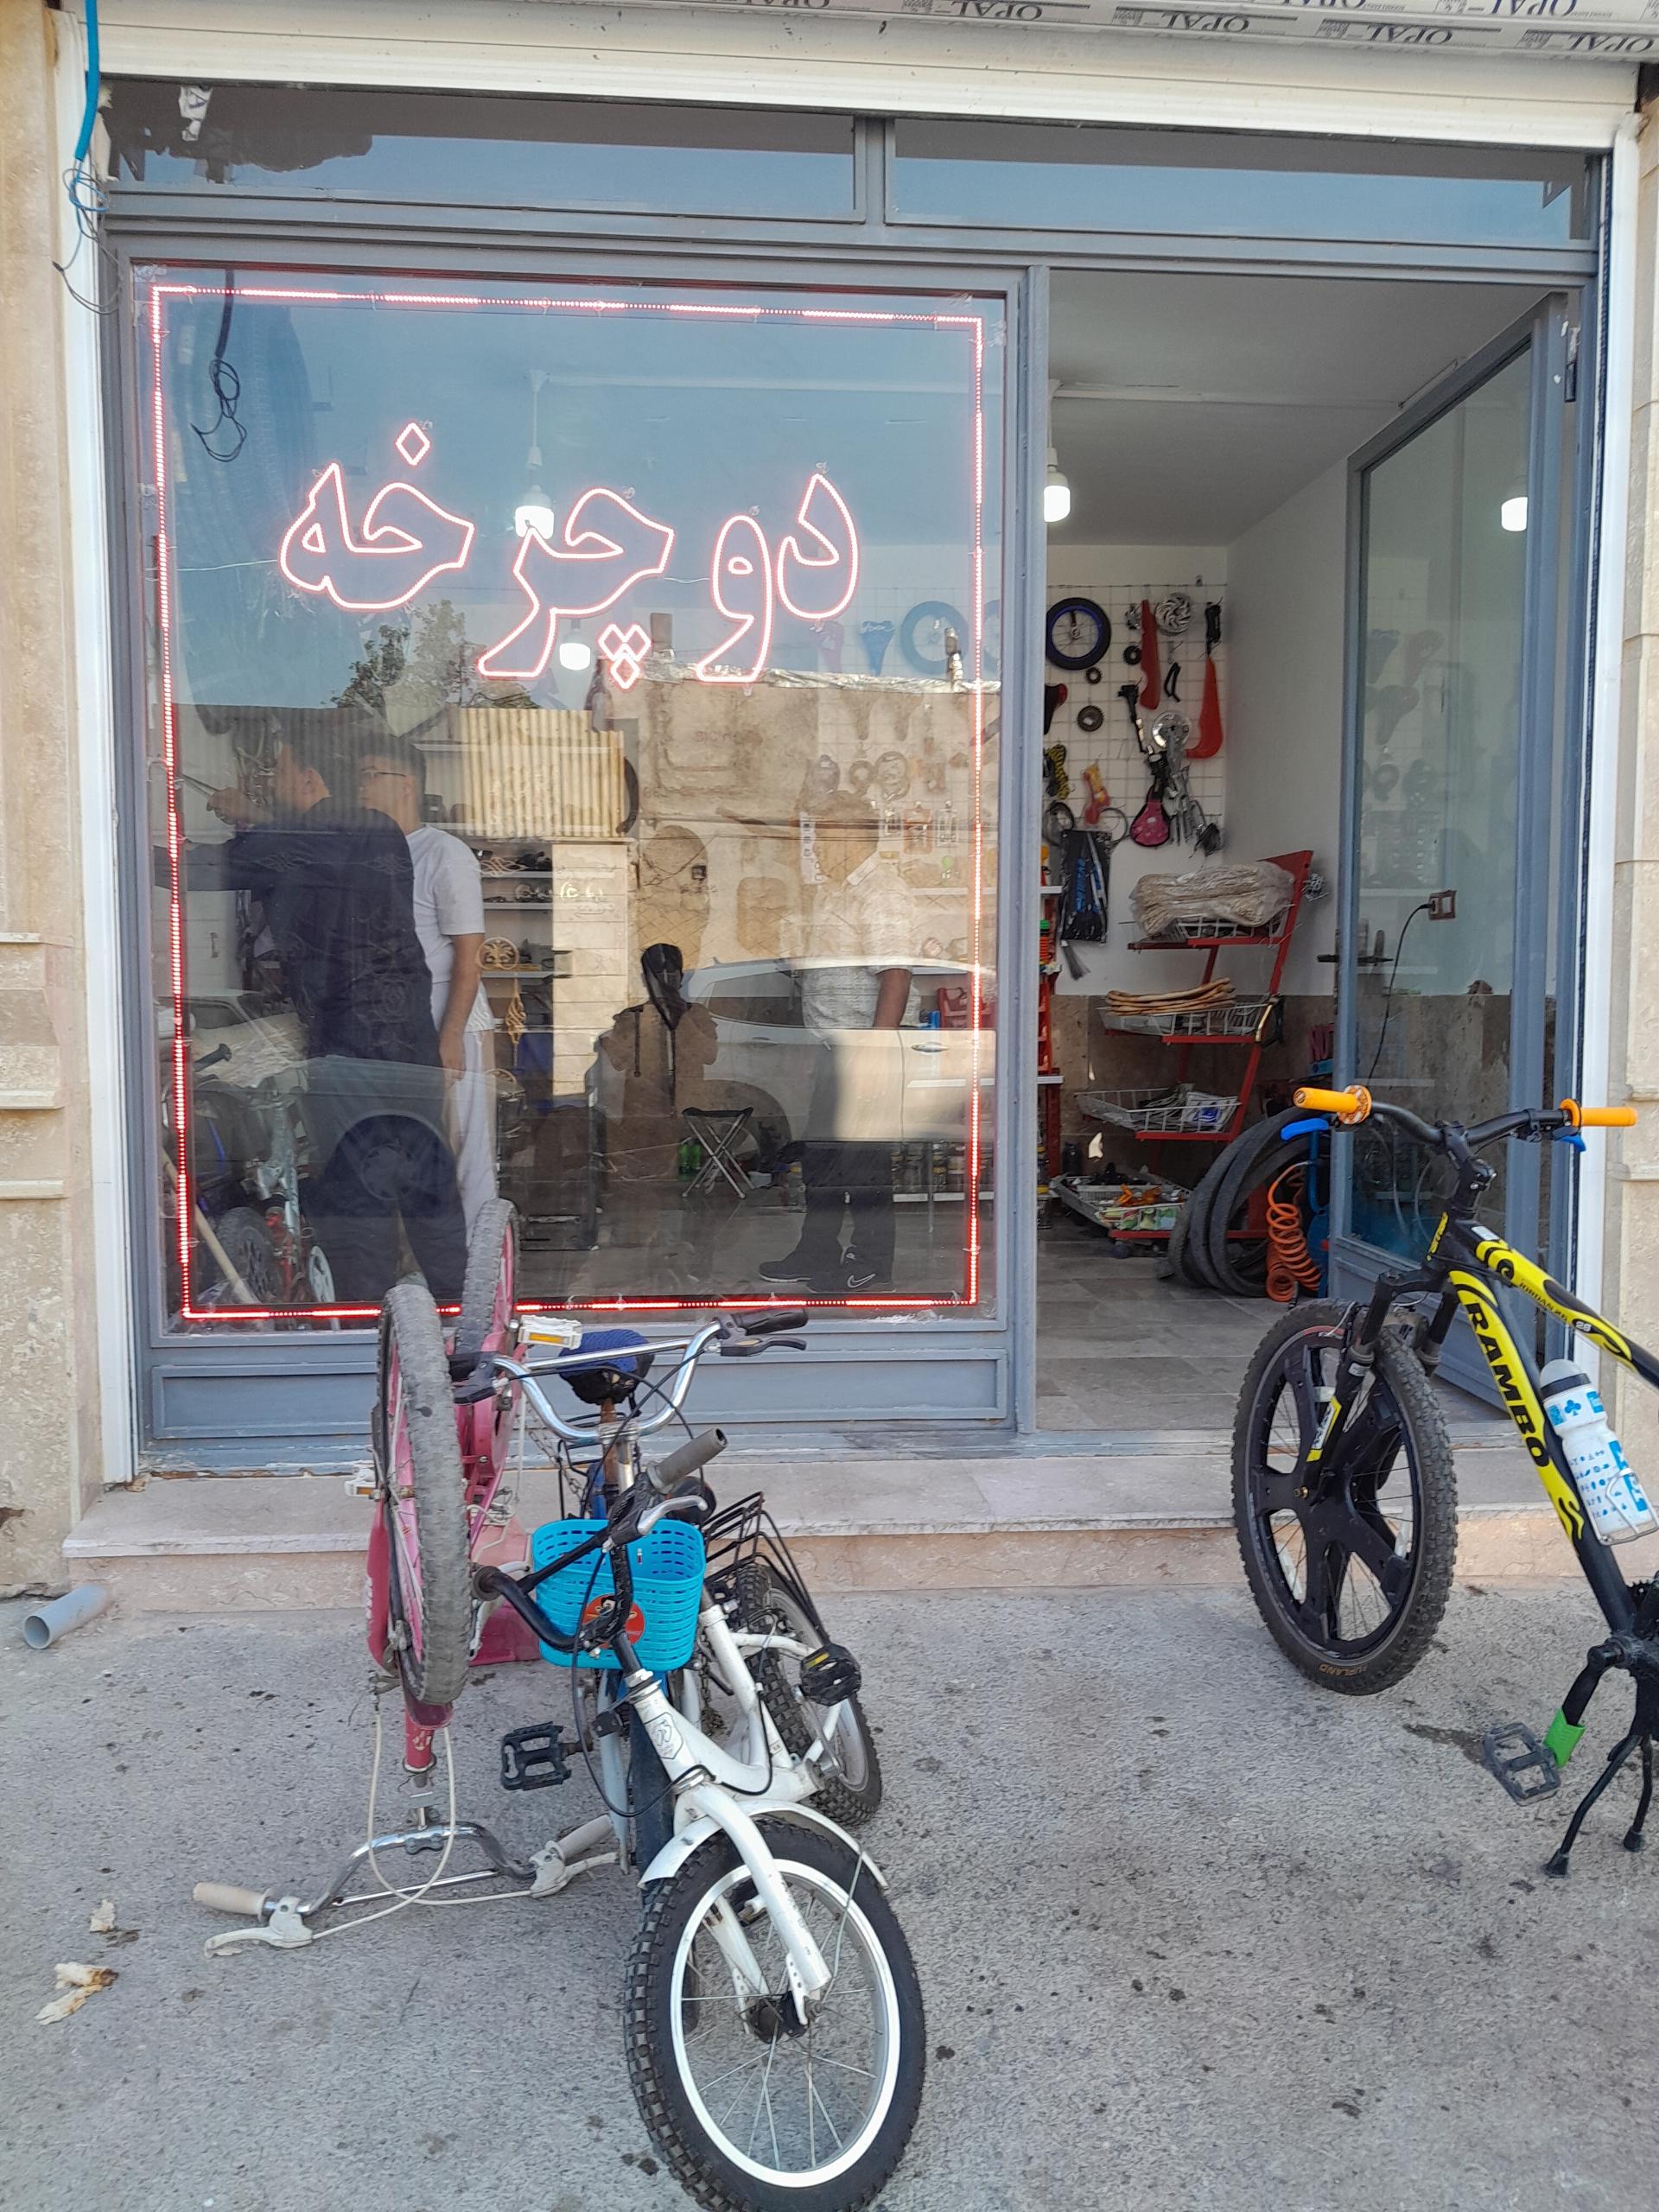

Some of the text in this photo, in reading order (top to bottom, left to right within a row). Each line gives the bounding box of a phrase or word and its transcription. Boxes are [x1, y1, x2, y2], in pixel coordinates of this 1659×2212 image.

[950, 2, 1042, 21] OPAL
[1161, 12, 1250, 33] OPAL
[1367, 23, 1453, 45] OPAL
[1569, 33, 1655, 53] OPAL
[1465, 1302, 1549, 1467] RAMBO
